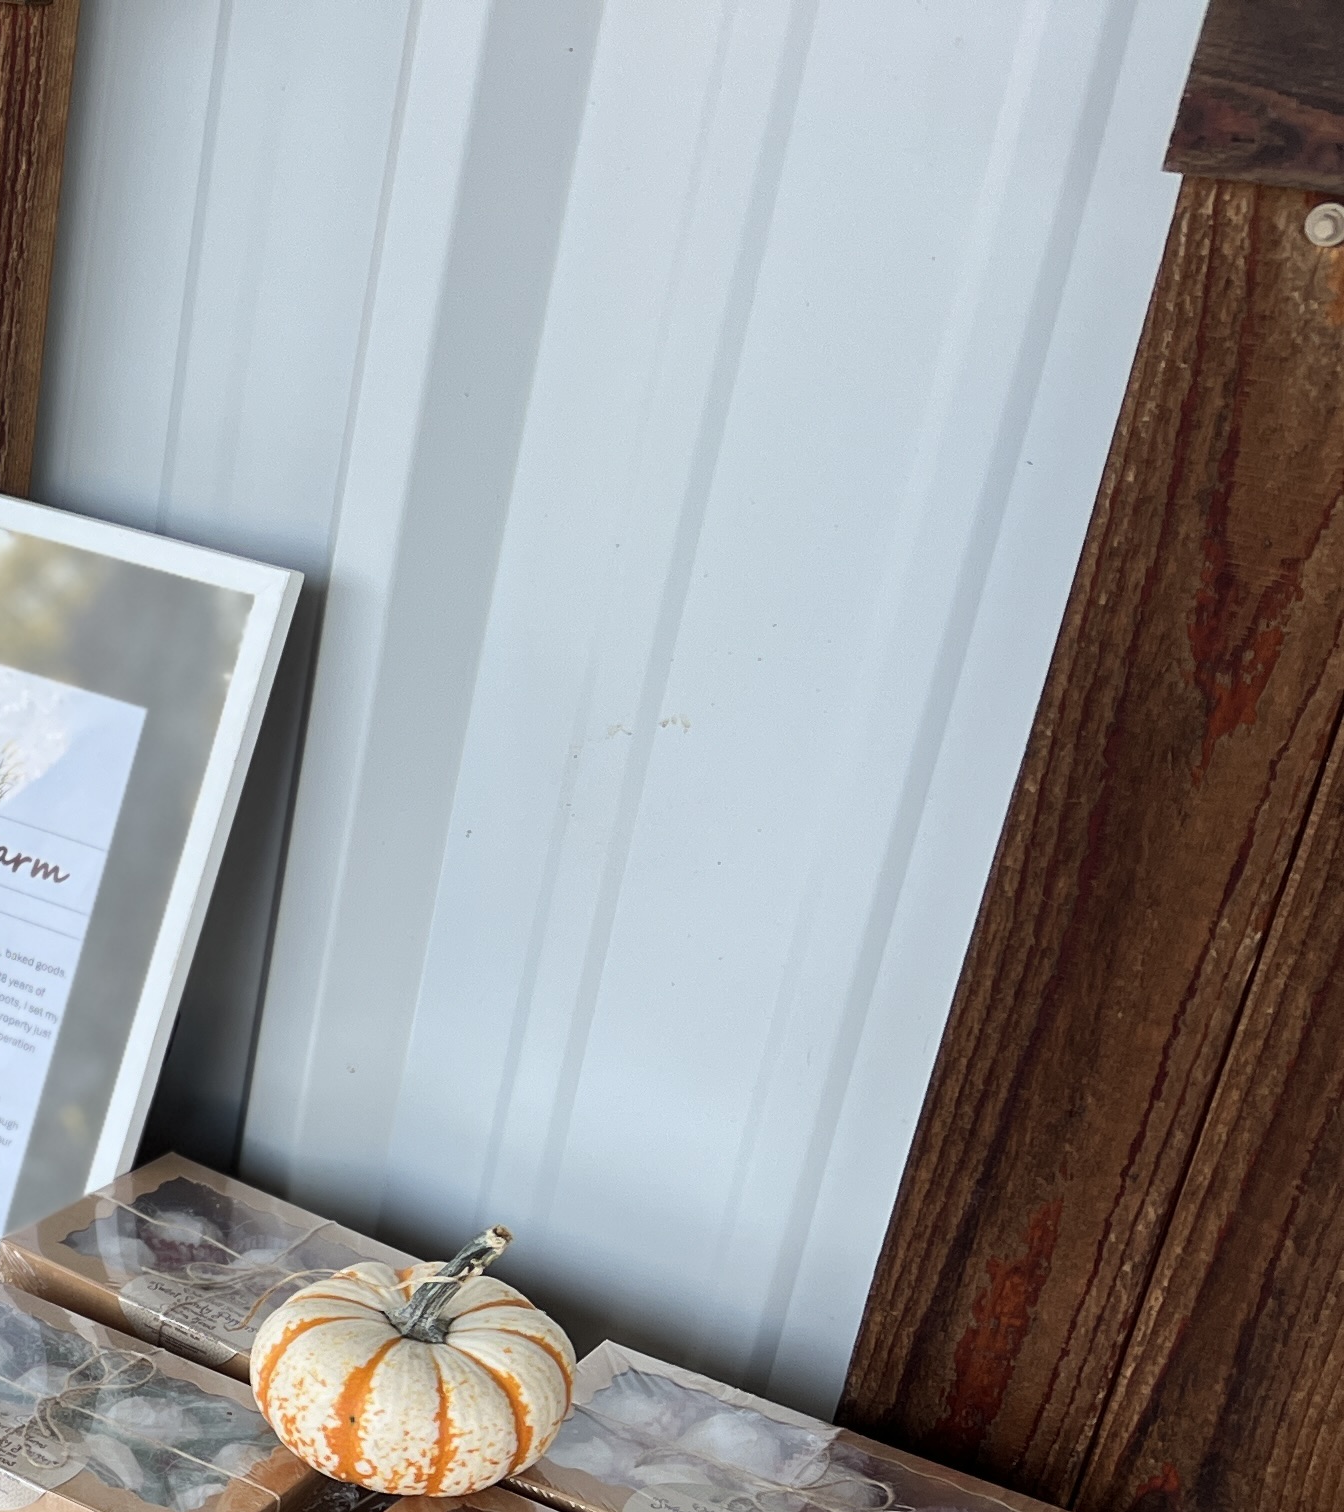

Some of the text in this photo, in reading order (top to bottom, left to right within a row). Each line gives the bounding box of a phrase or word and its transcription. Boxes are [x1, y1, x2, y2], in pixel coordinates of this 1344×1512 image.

[3, 947, 35, 967] baked
[6, 978, 33, 994] years
[34, 988, 45, 999] of
[28, 1005, 43, 1017] set
[44, 1011, 59, 1026] my
[32, 1025, 51, 1041] just
